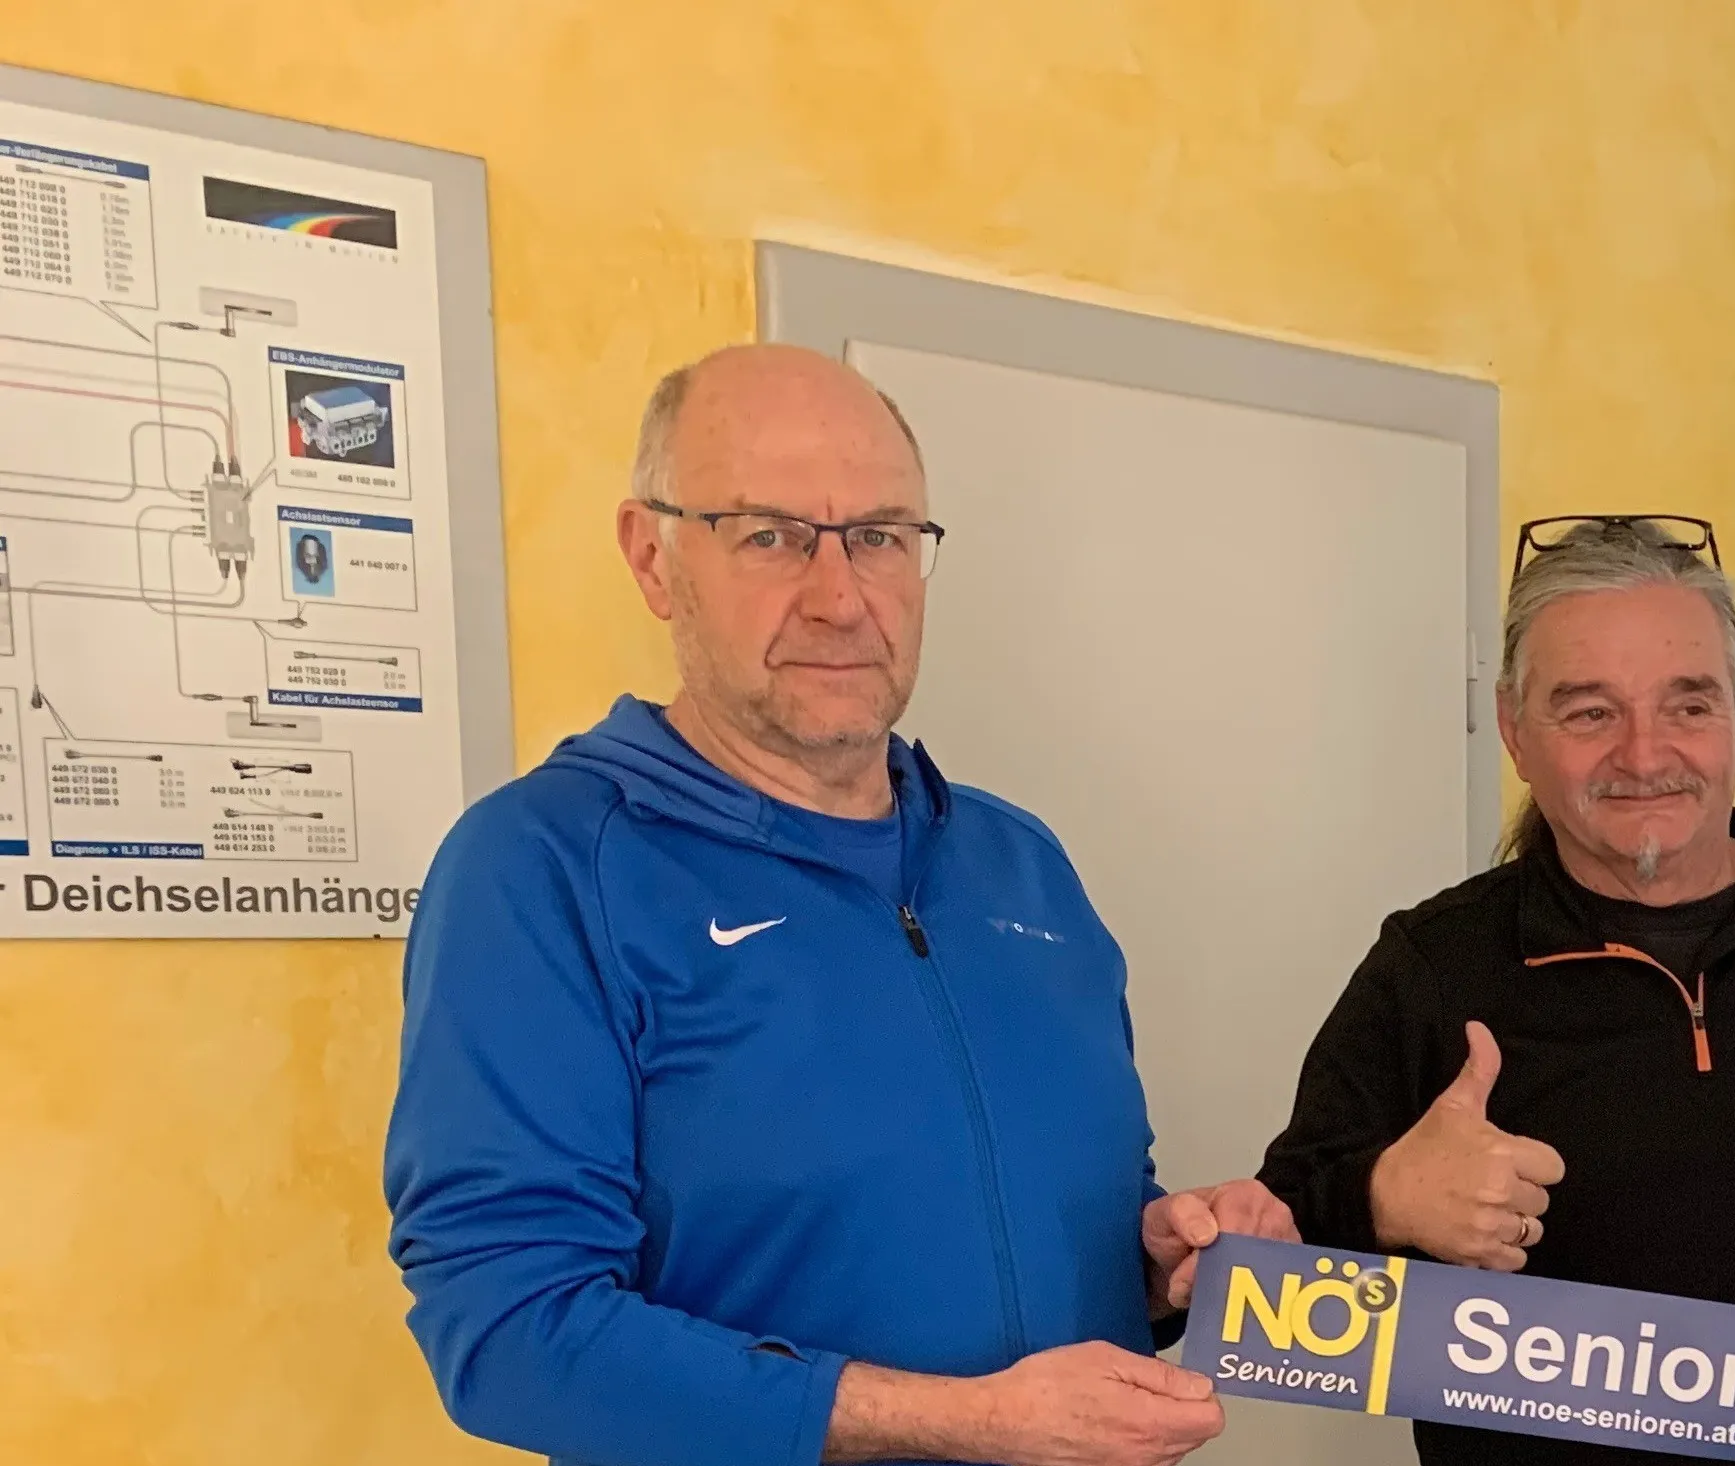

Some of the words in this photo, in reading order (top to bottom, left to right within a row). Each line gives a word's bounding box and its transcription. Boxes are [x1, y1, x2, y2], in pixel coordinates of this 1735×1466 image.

[273, 350, 400, 377] EBS-Anhängermodulator
[282, 509, 361, 526] Achslastsensor
[272, 693, 302, 703] Kabel
[304, 694, 318, 704] für
[322, 695, 399, 709] Achslastsensor
[56, 844, 109, 856] Diagnose
[1216, 1354, 1359, 1394] Senioren
